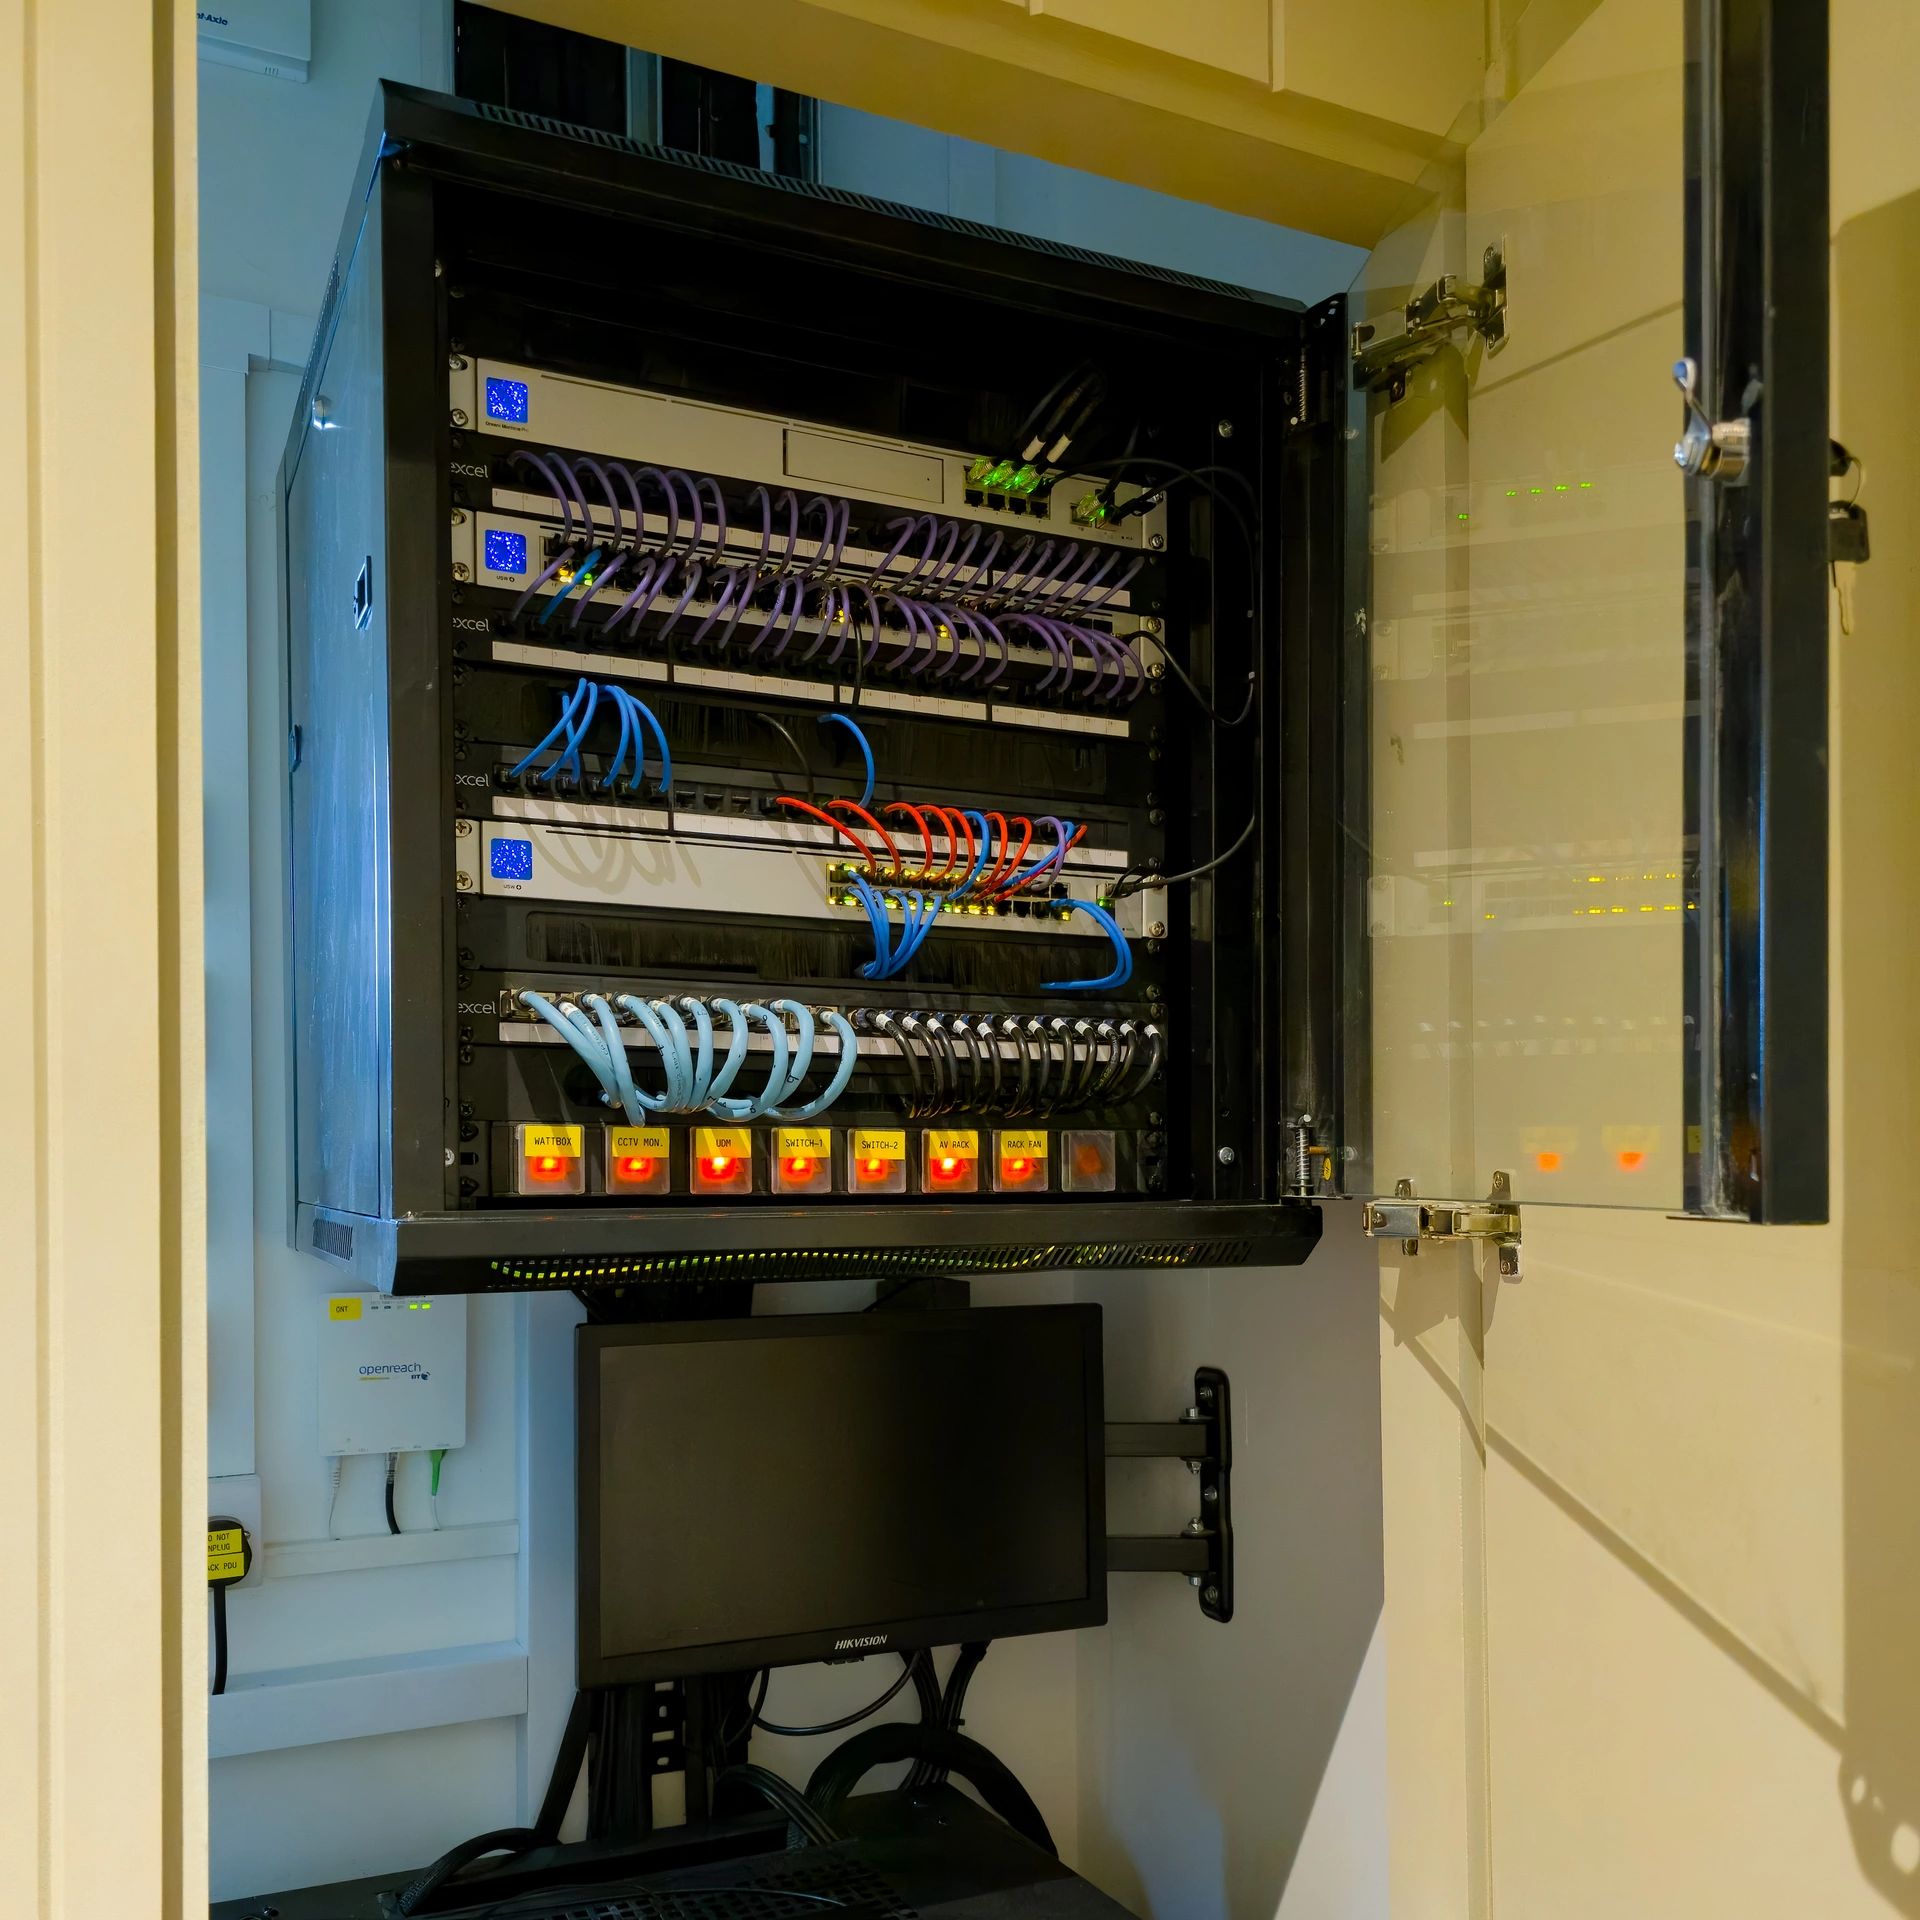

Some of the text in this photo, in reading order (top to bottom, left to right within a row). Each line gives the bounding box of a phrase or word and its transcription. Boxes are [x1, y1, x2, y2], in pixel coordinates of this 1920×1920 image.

[534, 1136, 573, 1146] WATTBOX
[617, 1137, 664, 1147] CCTV MON.
[715, 1138, 732, 1148] UDM
[785, 1137, 824, 1148] SWITCH-1
[861, 1139, 898, 1150] SWITCH-2
[939, 1140, 970, 1149] AV RACK
[1007, 1140, 1042, 1149] RACK FAN
[359, 1363, 421, 1376] openreach
[216, 1532, 230, 1541] NOT
[223, 1561, 237, 1570] PDU
[834, 1634, 888, 1650] HIKVISION
